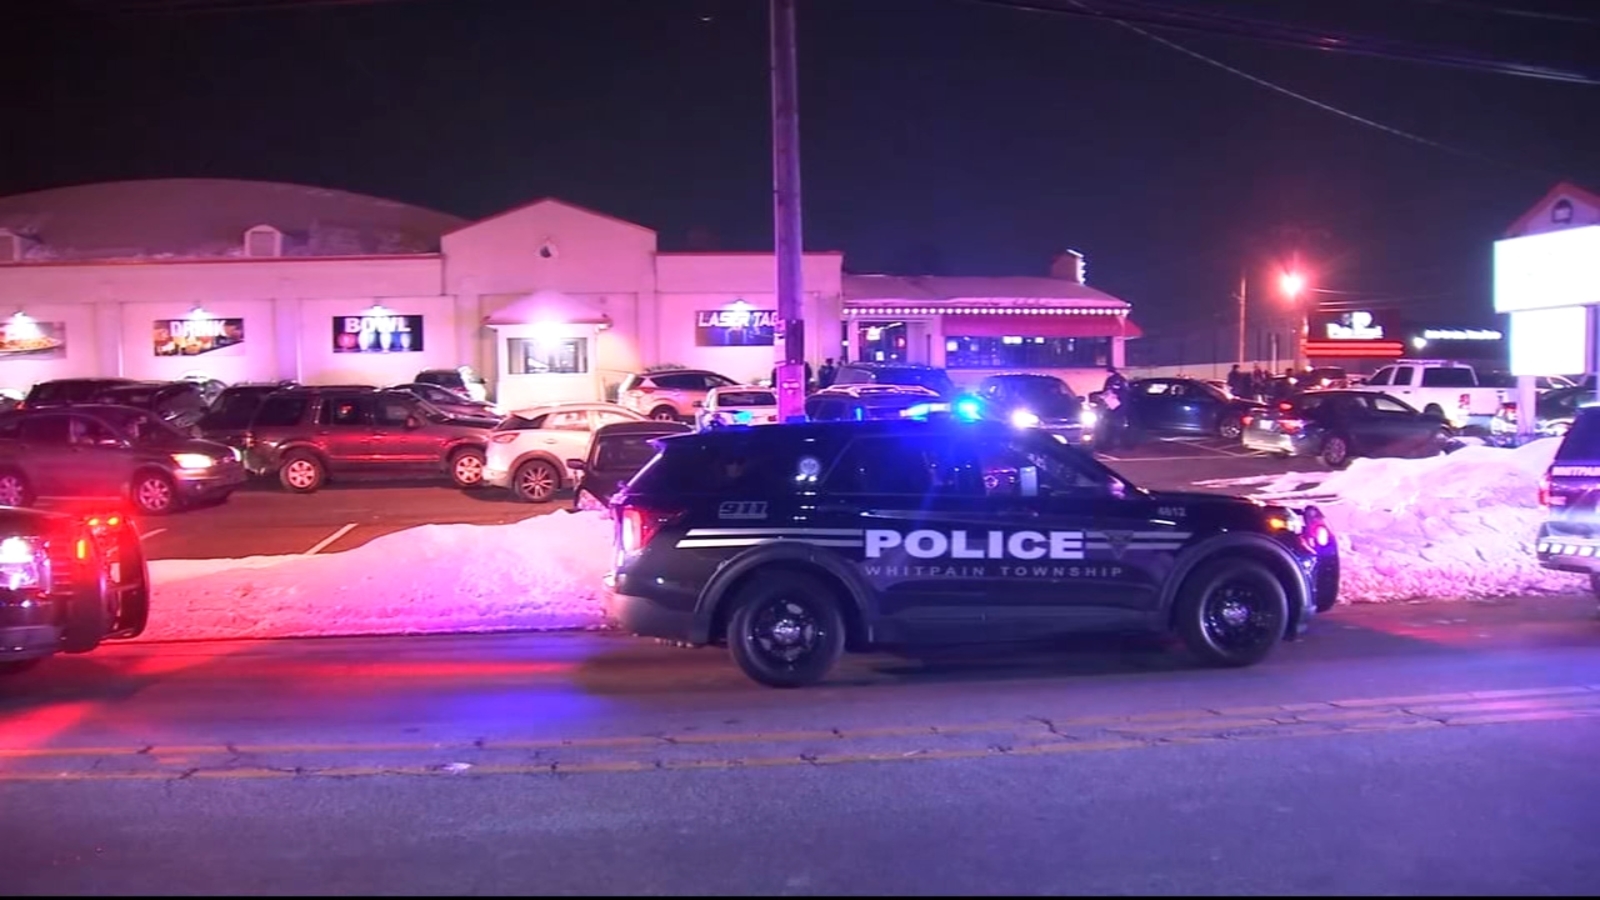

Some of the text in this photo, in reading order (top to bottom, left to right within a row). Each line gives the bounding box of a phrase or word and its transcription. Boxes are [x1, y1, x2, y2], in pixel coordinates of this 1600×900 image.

[345, 316, 412, 333] BOWL
[698, 311, 750, 327] LASER
[170, 320, 227, 337] DRINK
[719, 501, 767, 519] 911
[865, 529, 1085, 559] POLICE
[865, 566, 1123, 577] WHITPAIN TOWNSHIP
